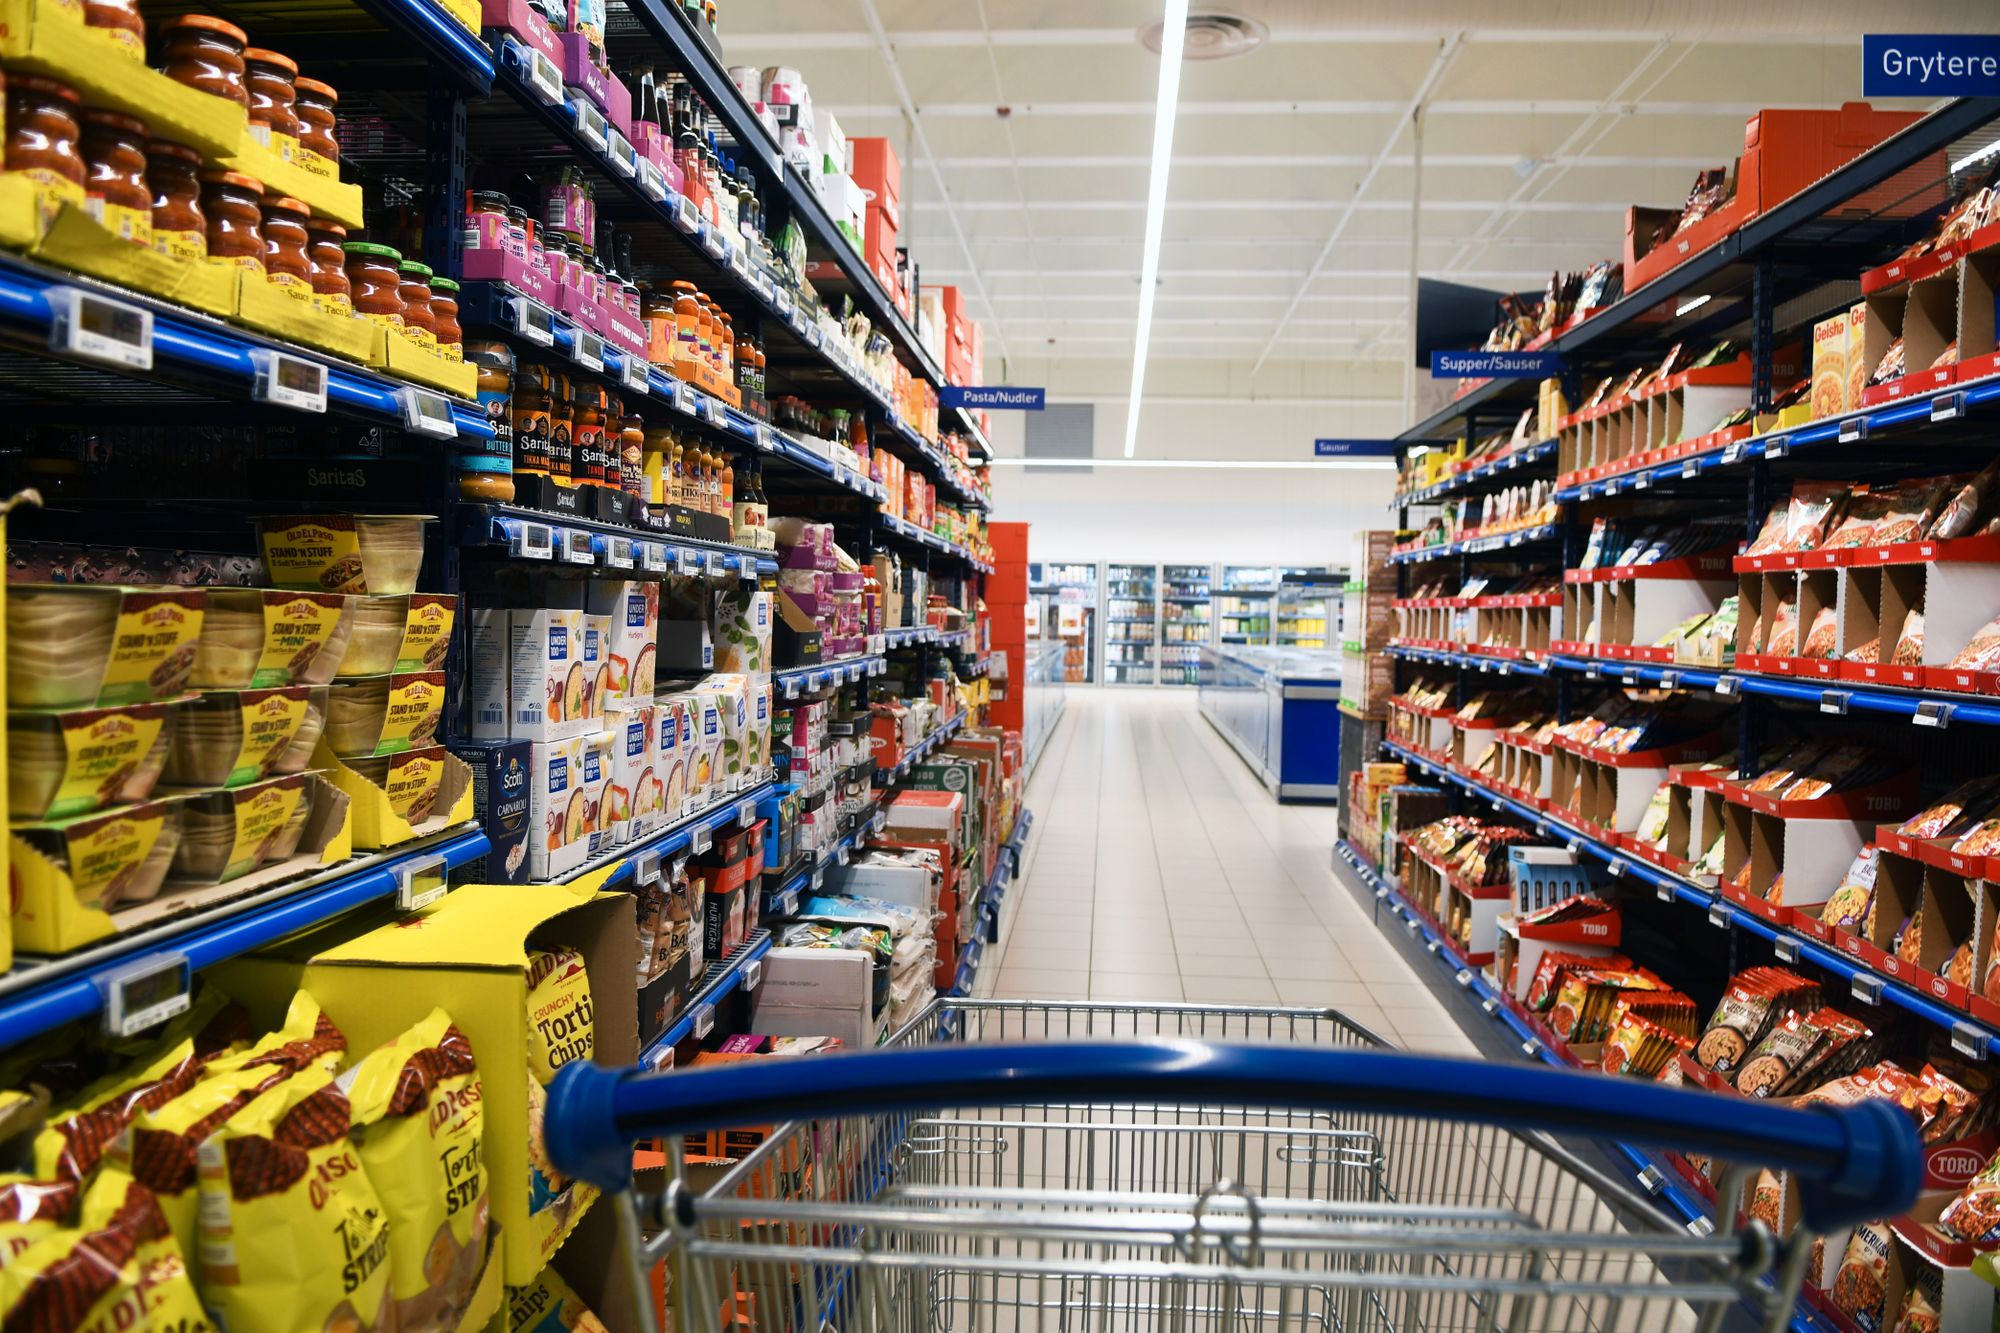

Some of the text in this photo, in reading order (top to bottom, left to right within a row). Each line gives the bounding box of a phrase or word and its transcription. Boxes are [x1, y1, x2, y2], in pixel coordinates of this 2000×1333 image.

[1883, 49, 1998, 83] Grytere
[305, 163, 330, 178] Sauce
[1814, 320, 1844, 343] Geisha
[1440, 356, 1543, 373] Supper/Sauser
[963, 390, 1038, 404] Pasta/Nudler
[1319, 442, 1350, 451] Sauser
[286, 529, 301, 541] OLD
[270, 547, 297, 558] STAND
[307, 546, 333, 557] STUFF
[1700, 558, 1726, 570] TORO
[629, 604, 645, 614] UNDER
[272, 623, 294, 635] STAND
[301, 623, 321, 634] STUFF
[408, 624, 423, 635] STAND
[427, 624, 441, 634] STUFF
[550, 636, 566, 646] UNDER
[404, 689, 414, 698] OLD
[390, 705, 408, 715] STAND
[413, 702, 429, 713] STUFF
[403, 765, 414, 776] OLD
[550, 766, 567, 779] UNDER
[388, 782, 405, 793] STAND
[411, 778, 427, 789] STUFF
[503, 770, 523, 790] Scotti
[497, 797, 527, 817] CARNAROLI
[707, 901, 718, 951] HURTIGRIS
[1582, 923, 1608, 936] TORO
[534, 992, 575, 1021] CRUNCHY
[537, 994, 593, 1048] Torti
[548, 1031, 593, 1070] Chips
[1937, 1156, 1978, 1174] TORO
